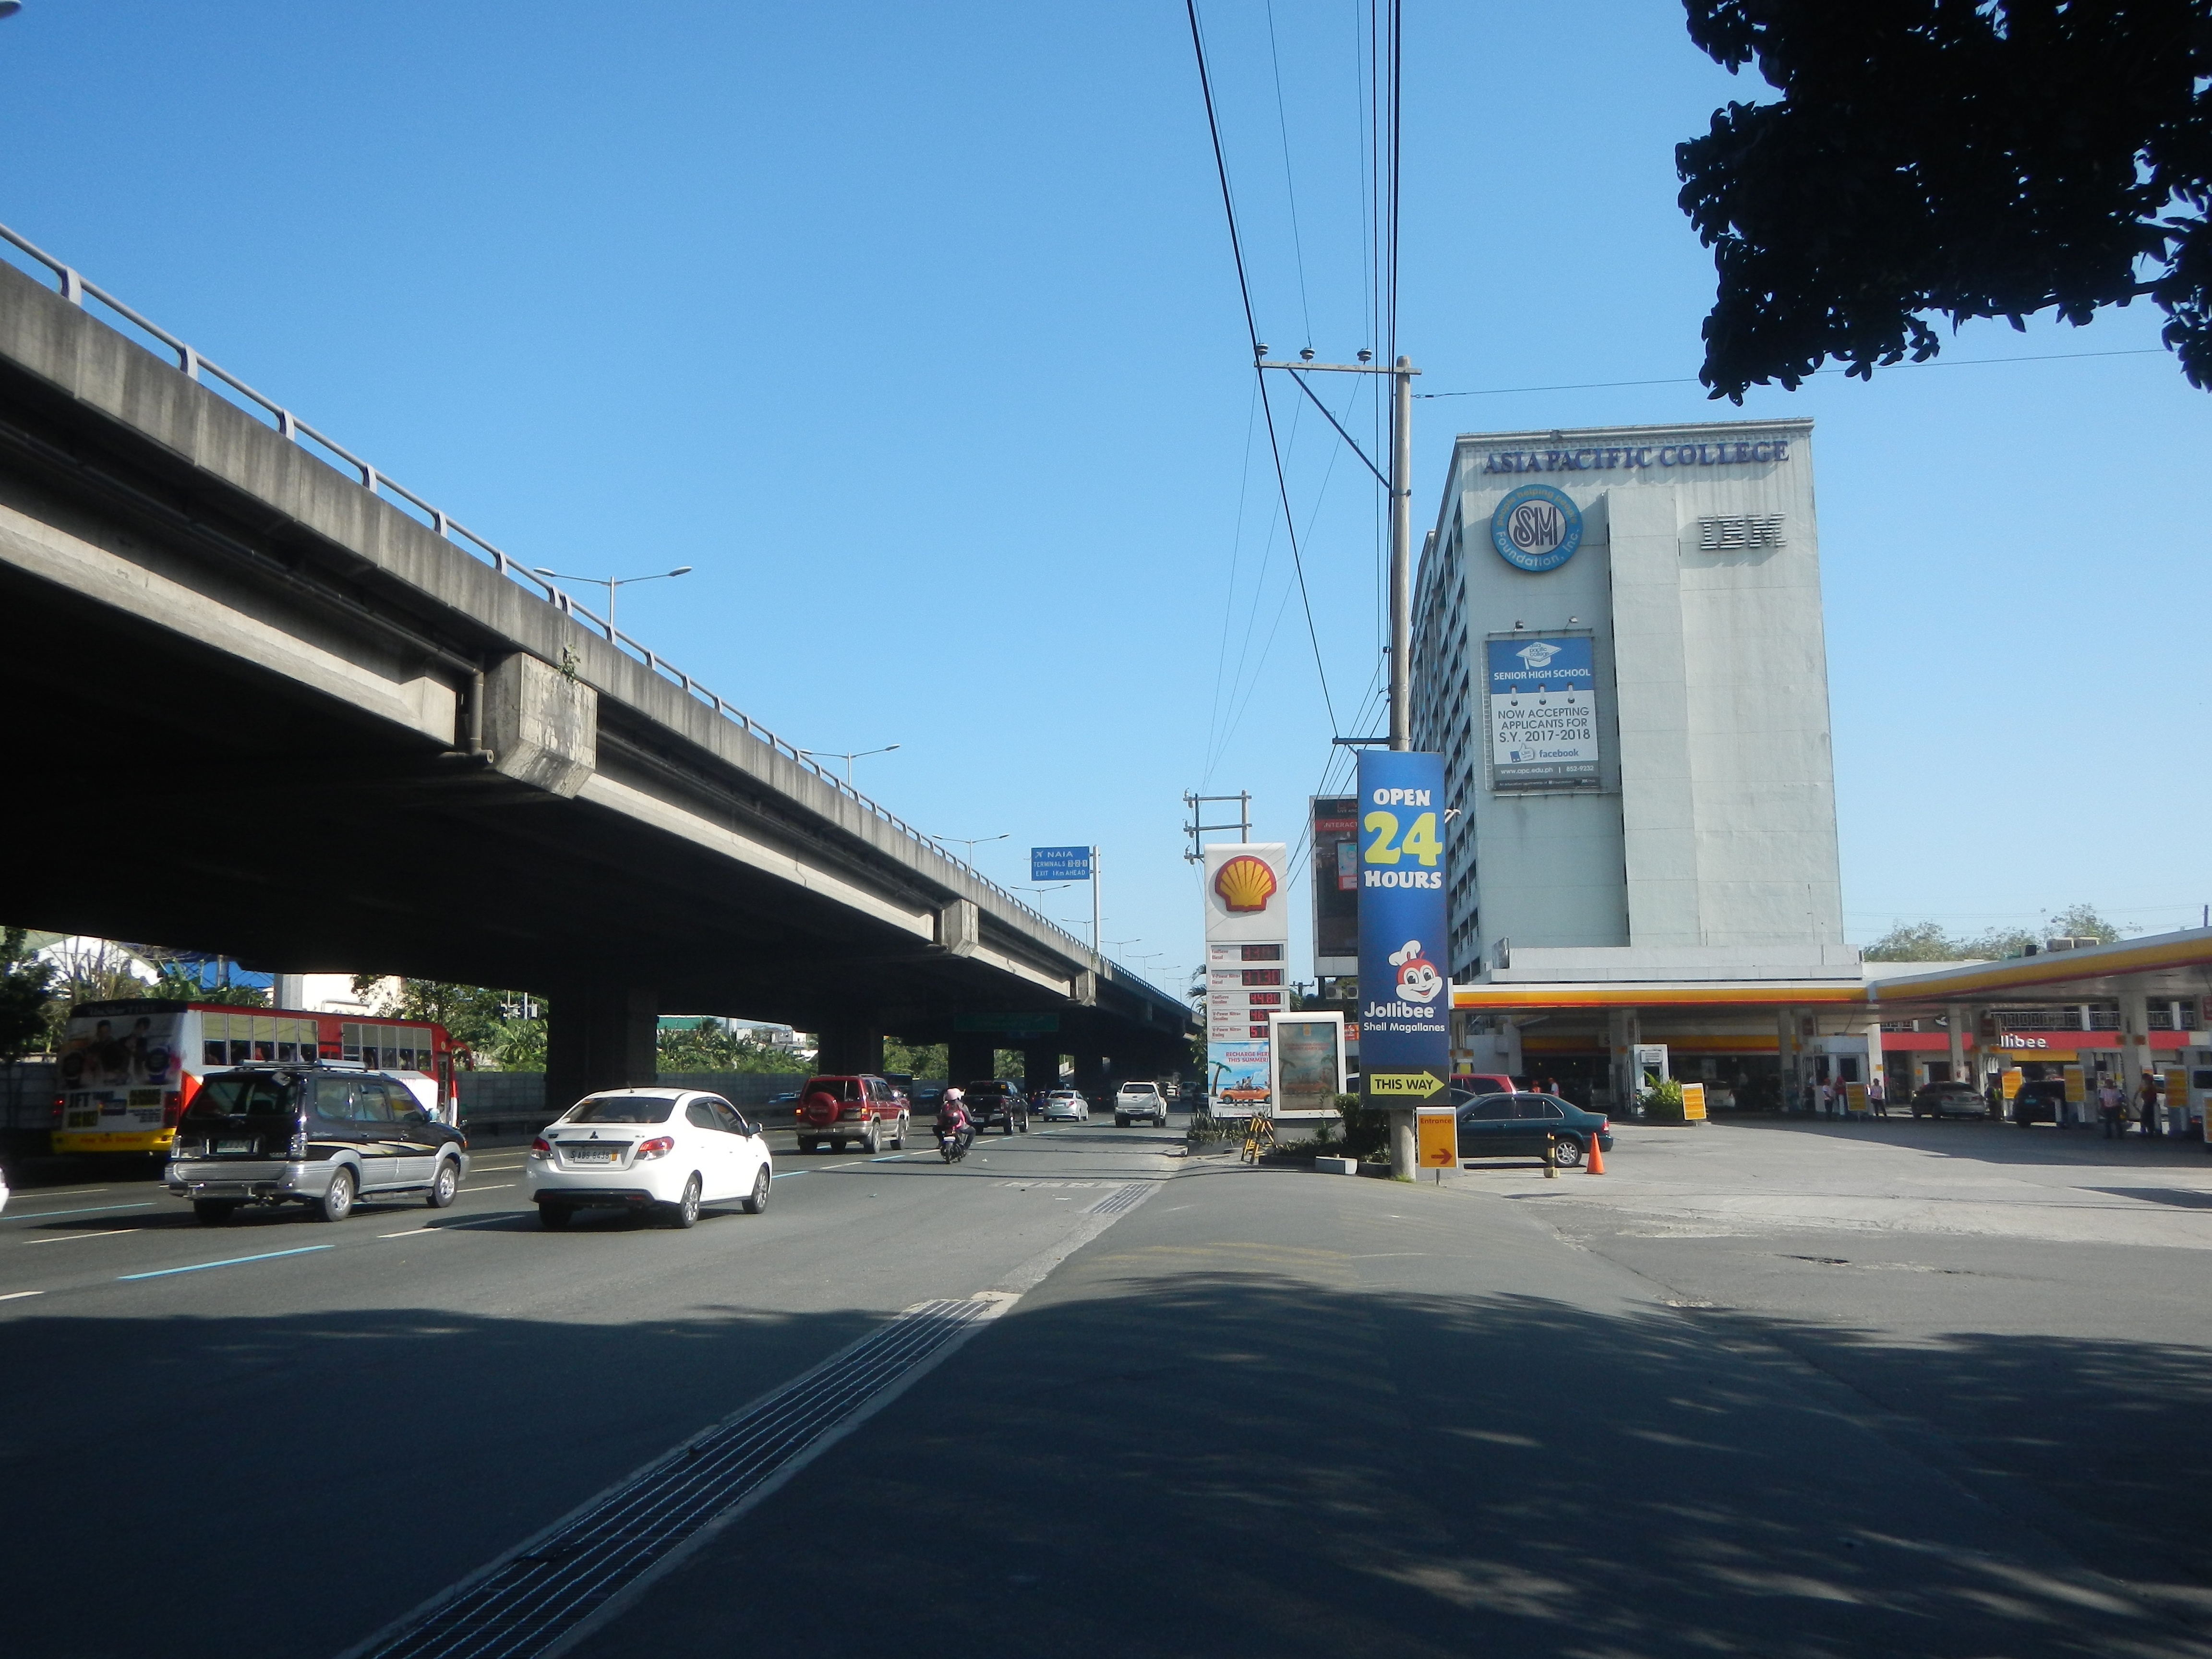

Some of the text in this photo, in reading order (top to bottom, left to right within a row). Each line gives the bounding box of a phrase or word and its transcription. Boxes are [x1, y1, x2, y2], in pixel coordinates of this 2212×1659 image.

[1483, 441, 1790, 474] ASIA PACIFIC COLLEGE
[1513, 505, 1558, 548] SM
[1698, 512, 1788, 549] IBM
[1494, 668, 1591, 680] SENIOR HIGH SCHOOL
[1498, 707, 1589, 719] NOW ACCEPTING
[1501, 718, 1587, 730] APPLICANTS FOR
[1499, 729, 1590, 743] S.Y. 2017-2018
[1539, 748, 1579, 758] facebook
[1373, 788, 1431, 806] OPEN
[1364, 811, 1443, 866] 24
[1364, 870, 1442, 890] HOURS
[1364, 1001, 1434, 1018] Jollibee
[1363, 1022, 1445, 1034] Shell Magallanes
[1374, 1079, 1434, 1090] THIS WAY
